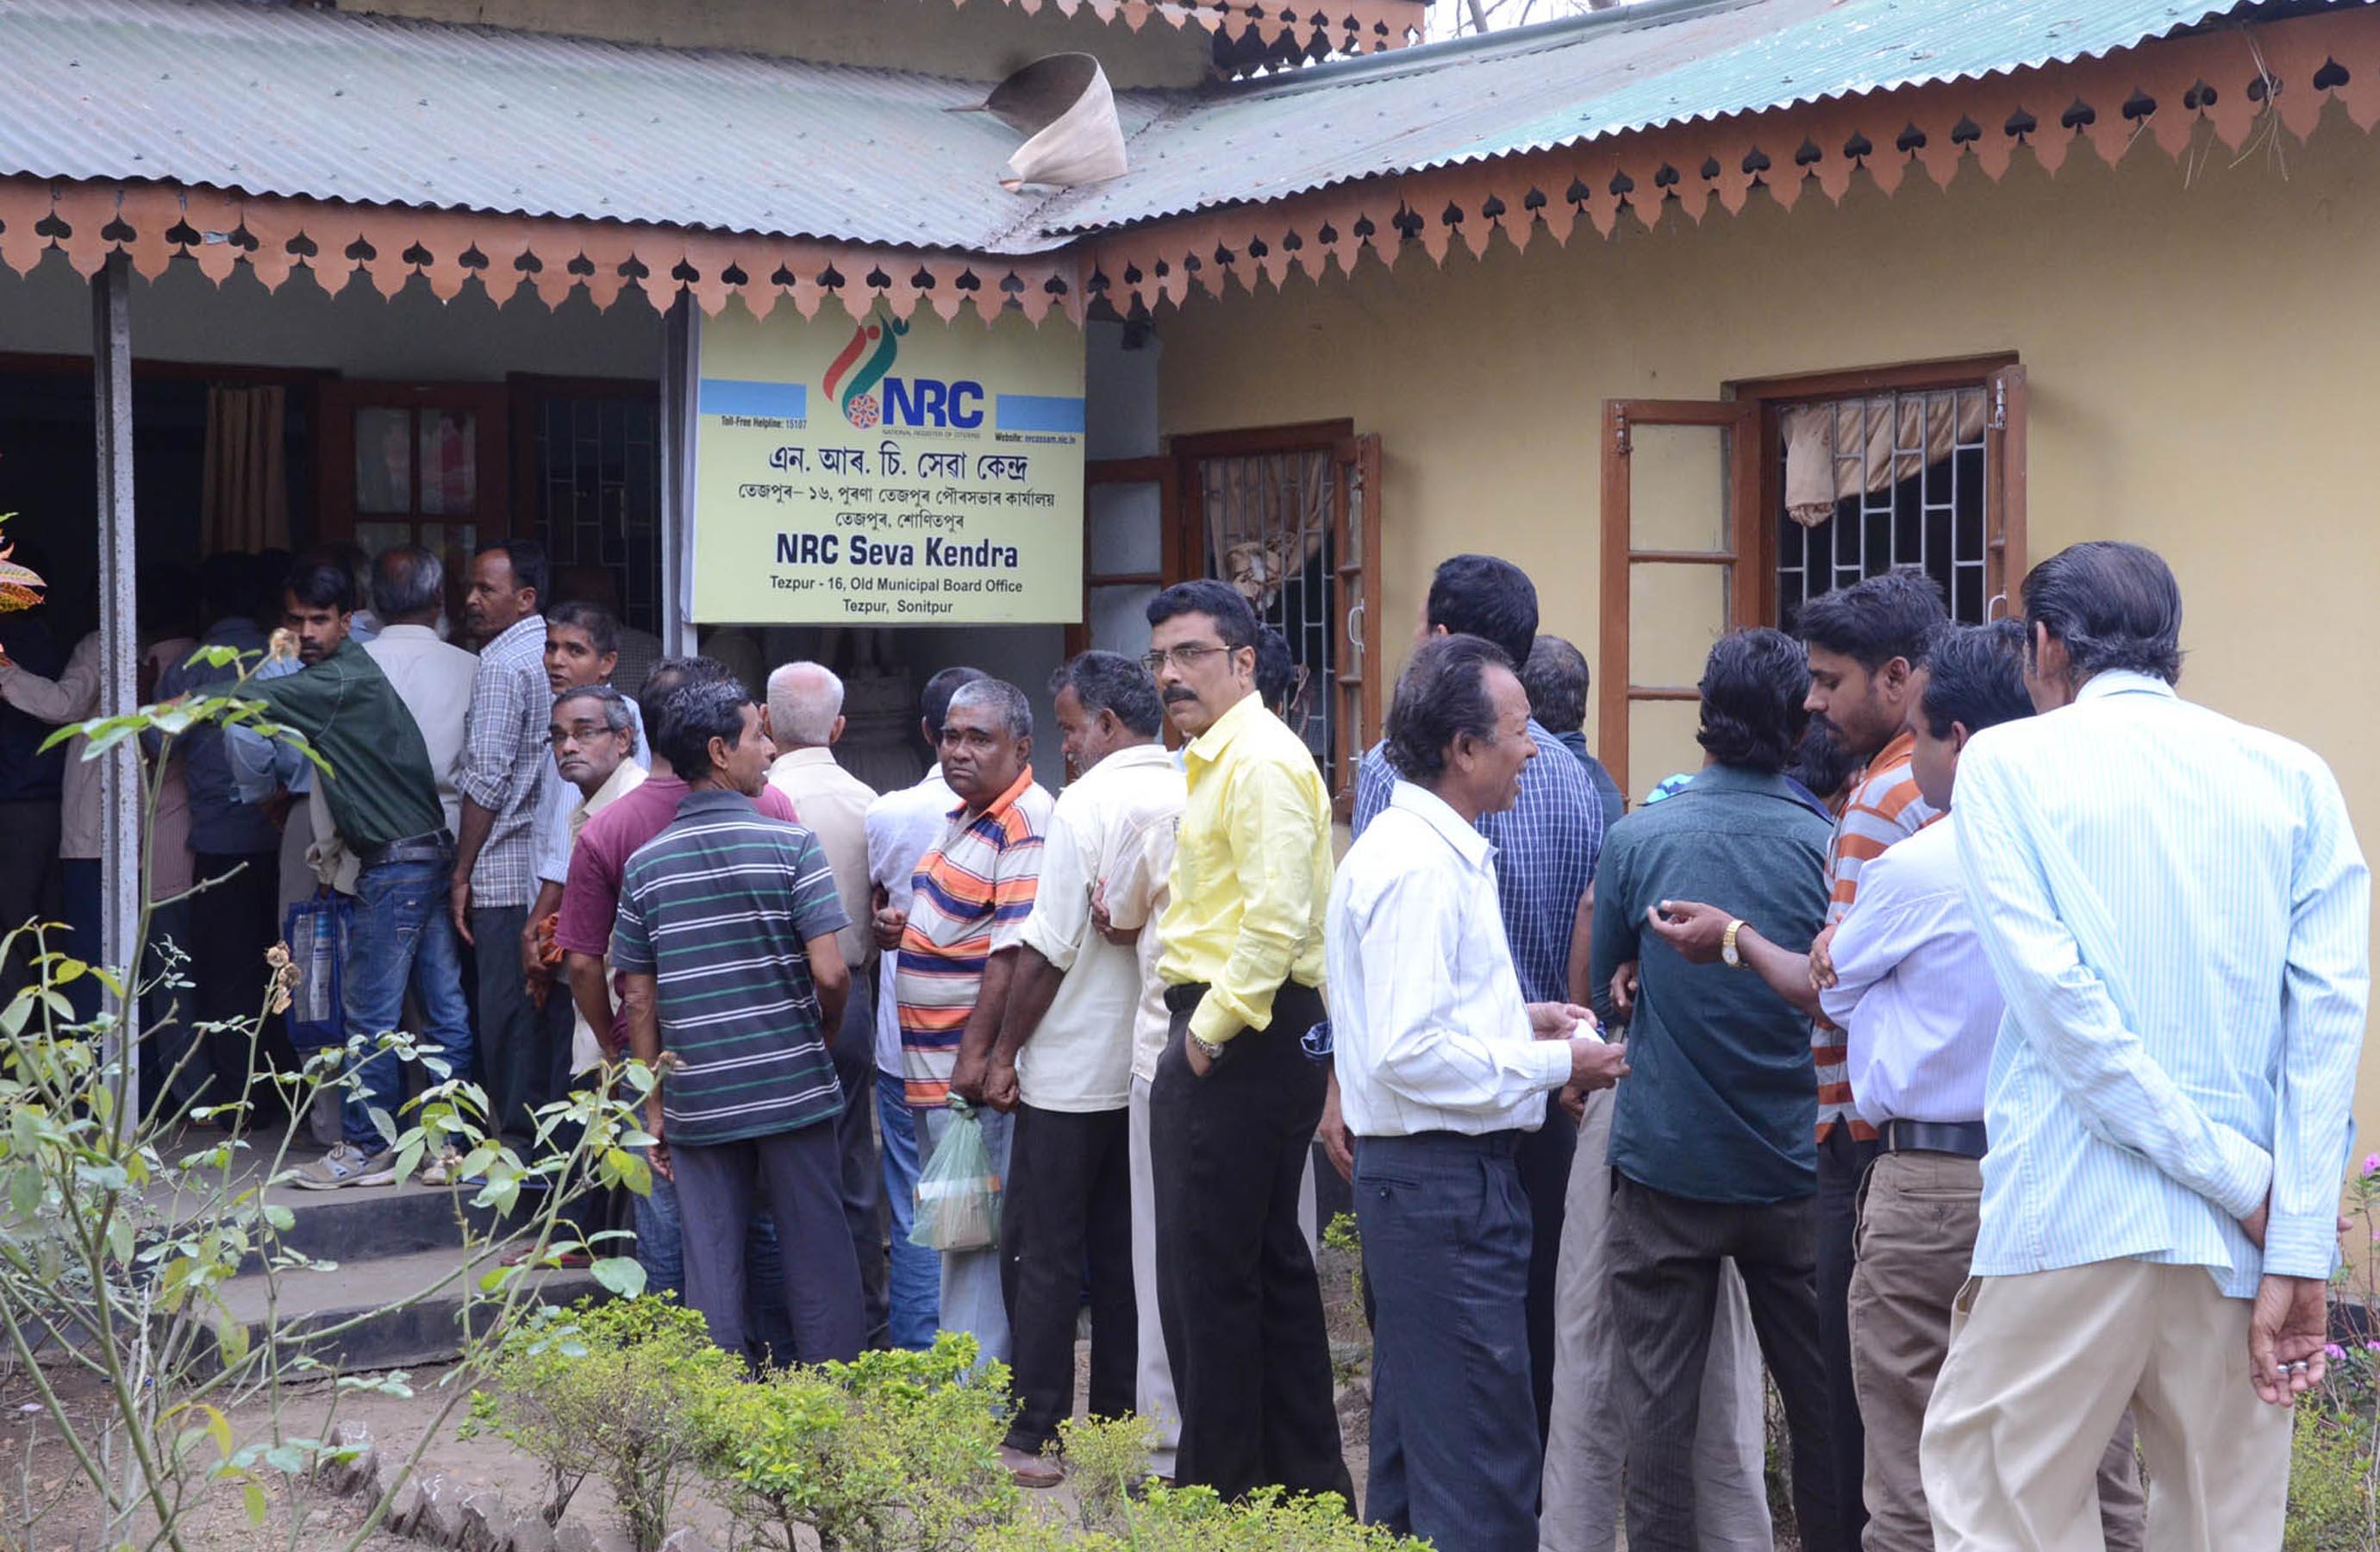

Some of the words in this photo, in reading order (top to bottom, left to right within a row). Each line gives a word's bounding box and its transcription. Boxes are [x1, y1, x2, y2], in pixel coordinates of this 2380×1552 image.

[883, 378, 984, 429] NRC
[995, 433, 1022, 441] Website:
[770, 447, 810, 472] এন.
[818, 447, 870, 474] আৰ.
[878, 441, 906, 476] চি.
[918, 452, 967, 479] সেৱা
[978, 455, 1028, 481] কেন্দ্ৰ
[879, 490, 930, 507] তেজপুৰ
[936, 487, 1002, 505] পৌৰসভাৰ
[898, 510, 964, 532] শোণিতপুৰ
[778, 534, 838, 564] NRC
[850, 535, 913, 566] Seva
[926, 537, 1017, 567] Kendra
[771, 576, 815, 591] Tezpur
[828, 577, 846, 591] 16,
[851, 577, 872, 590] Old
[878, 578, 939, 593] Municipal
[944, 579, 982, 591] Board
[986, 579, 1022, 592] Office
[843, 599, 889, 615] Tezpur,
[897, 600, 953, 615] Sonitpur
